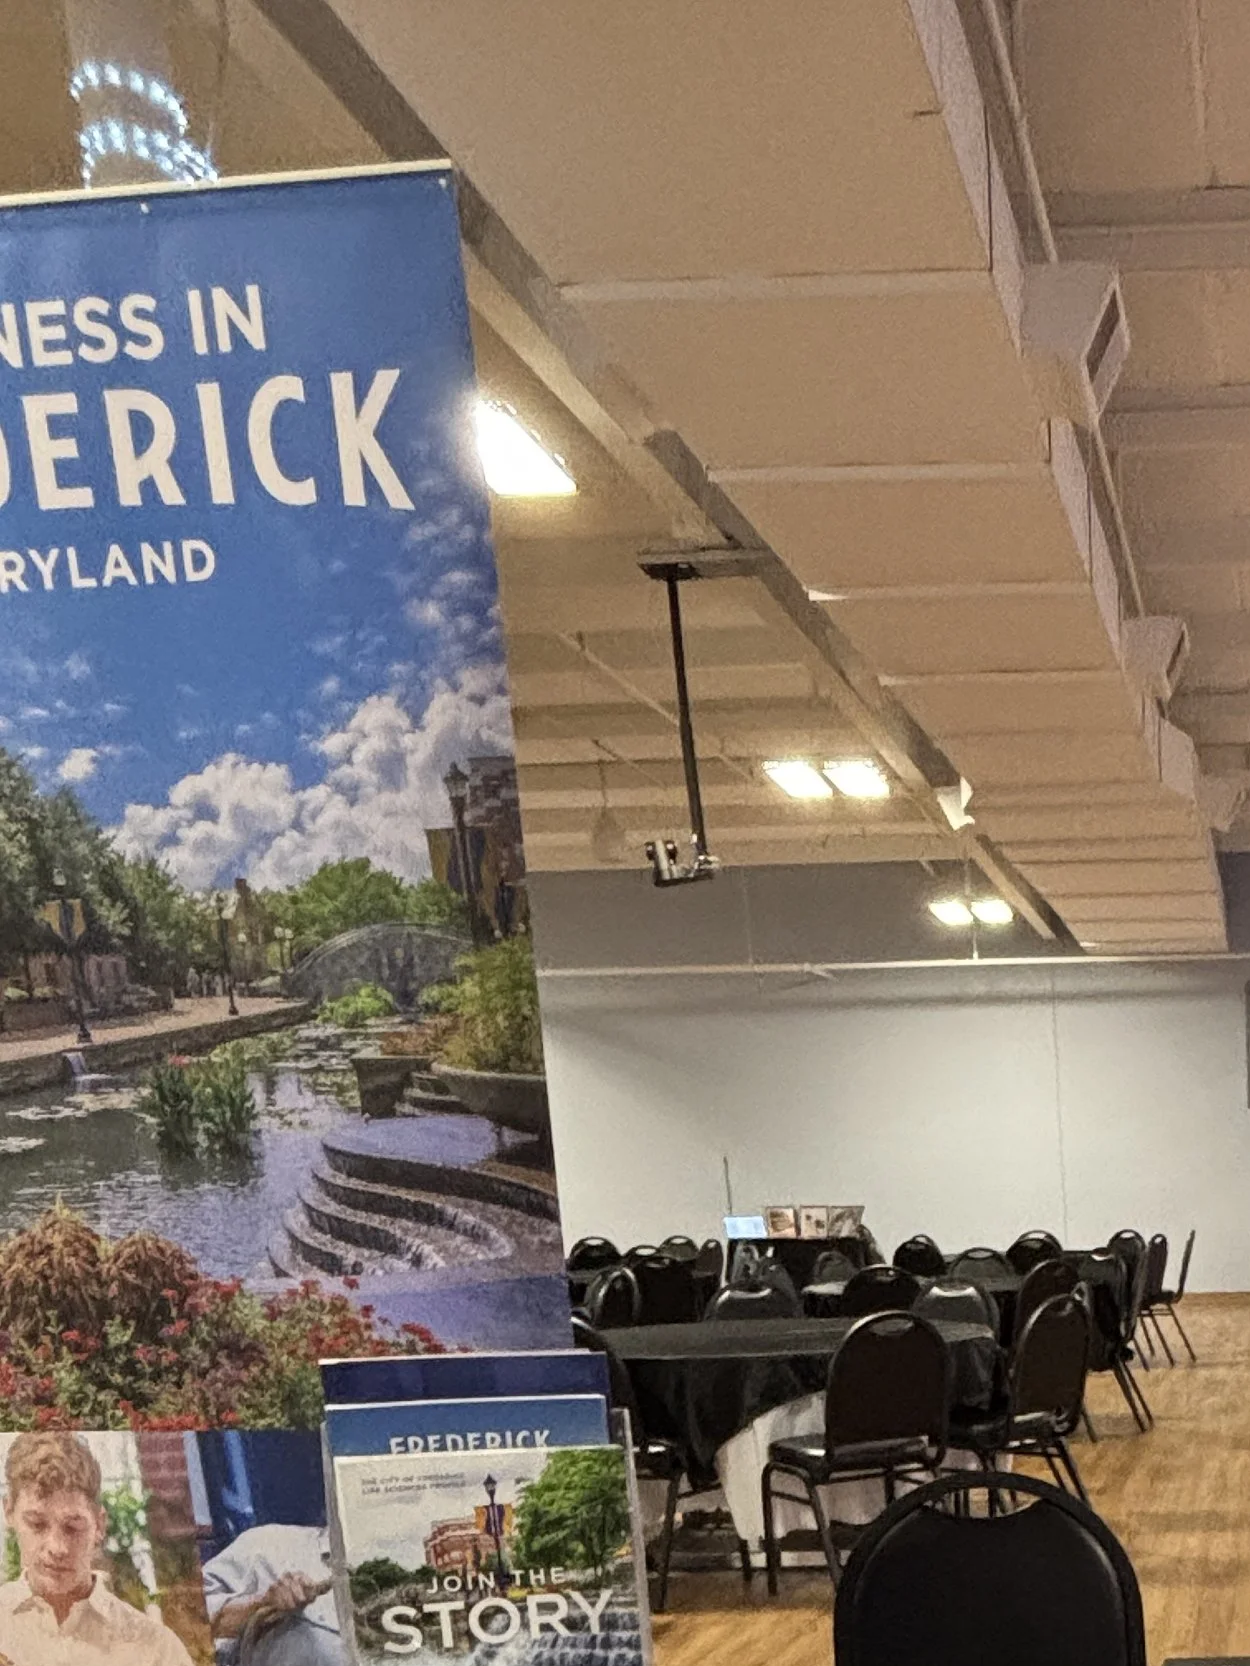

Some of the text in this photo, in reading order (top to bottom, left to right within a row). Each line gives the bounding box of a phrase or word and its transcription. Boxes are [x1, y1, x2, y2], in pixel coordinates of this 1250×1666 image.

[187, 284, 266, 355] IN
[0, 368, 415, 511] ERICK
[0, 539, 215, 593] RYLAND
[389, 1429, 550, 1454] FREDERICK
[427, 1567, 565, 1594] JOIN THE
[381, 1589, 613, 1654] STORY
